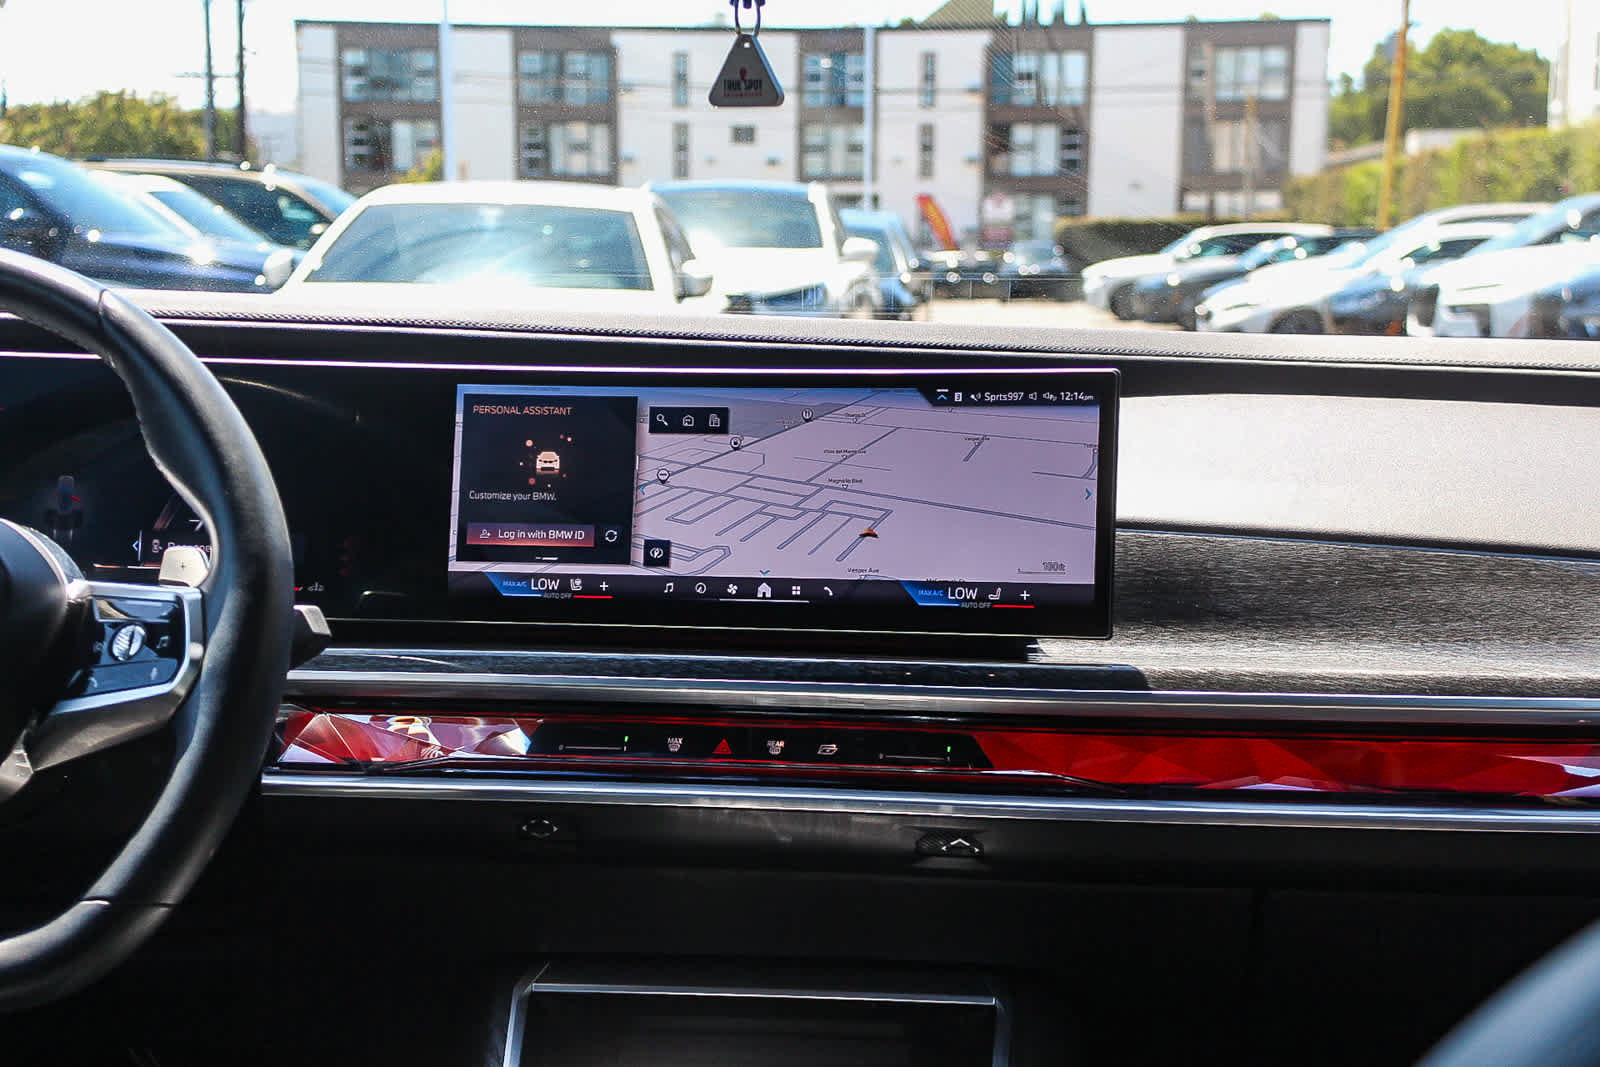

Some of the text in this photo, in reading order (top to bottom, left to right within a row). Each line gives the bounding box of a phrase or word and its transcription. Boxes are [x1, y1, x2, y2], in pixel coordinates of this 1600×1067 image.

[984, 391, 1024, 402] Sprts997
[472, 405, 572, 416] PERSONAL ASSISTANT
[469, 490, 557, 502] Customize your BMW.
[498, 529, 585, 541] Log in with BMW ID
[531, 578, 560, 590] LOW
[947, 587, 978, 600] LOW
[667, 737, 683, 745] MAX
[767, 740, 785, 748] REAR
